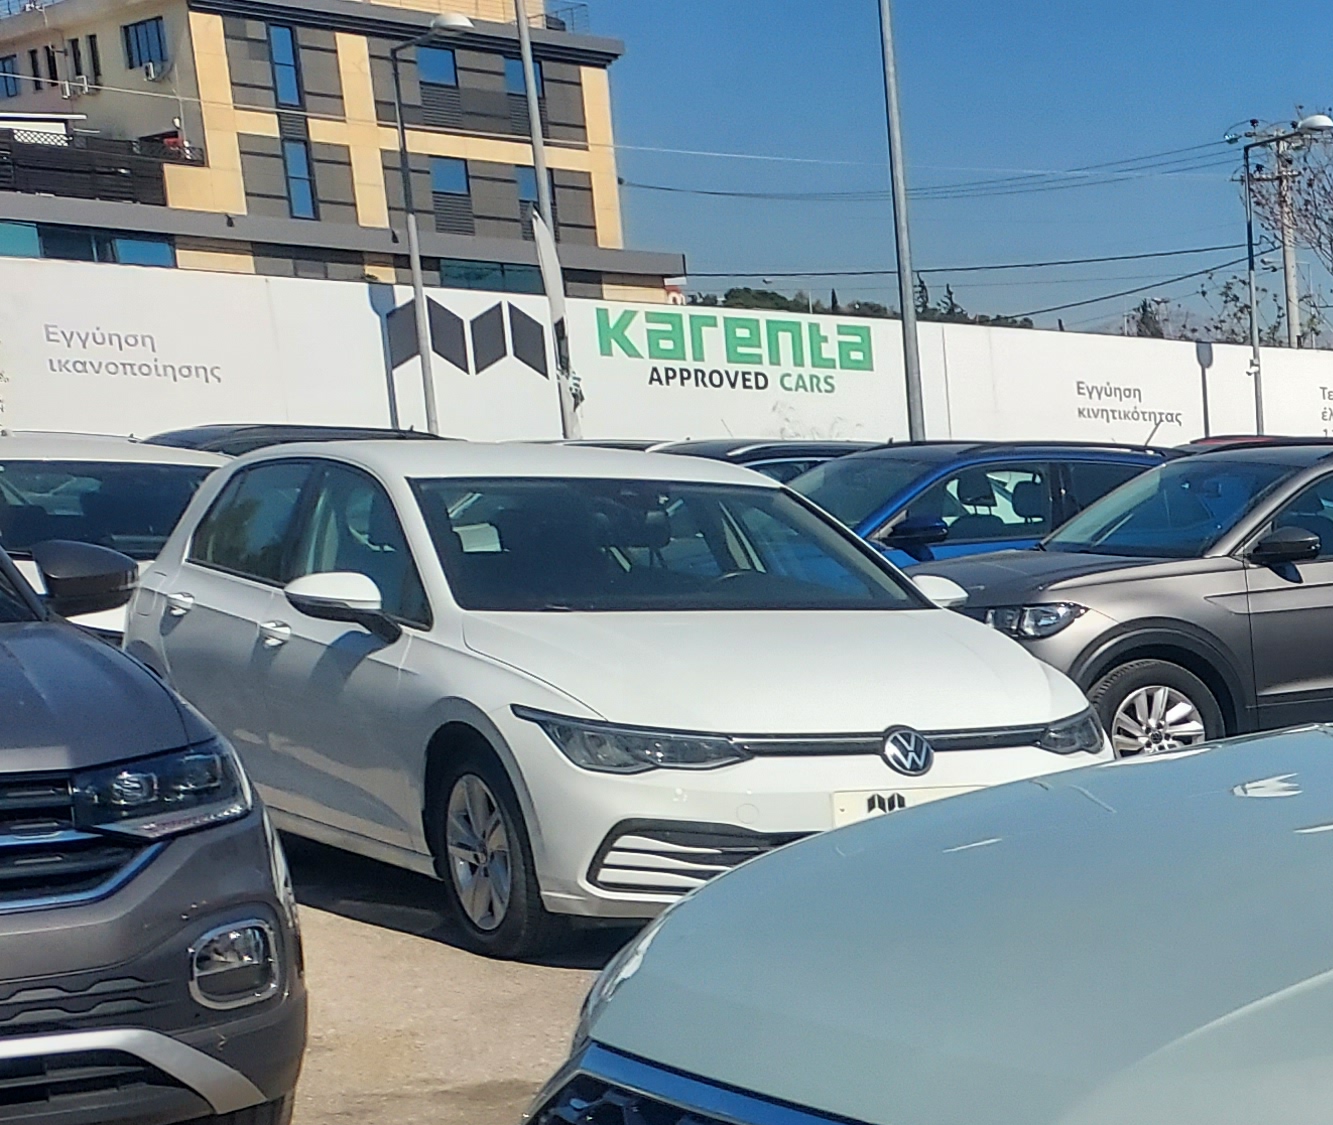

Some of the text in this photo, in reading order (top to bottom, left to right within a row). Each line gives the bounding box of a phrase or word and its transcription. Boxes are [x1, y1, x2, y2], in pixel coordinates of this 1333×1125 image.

[43, 323, 157, 353] Εγγύηση
[48, 356, 223, 384] ικανοποίησης
[648, 366, 836, 394] APPROVED CARS
[1076, 381, 1142, 403] Εγγύηση
